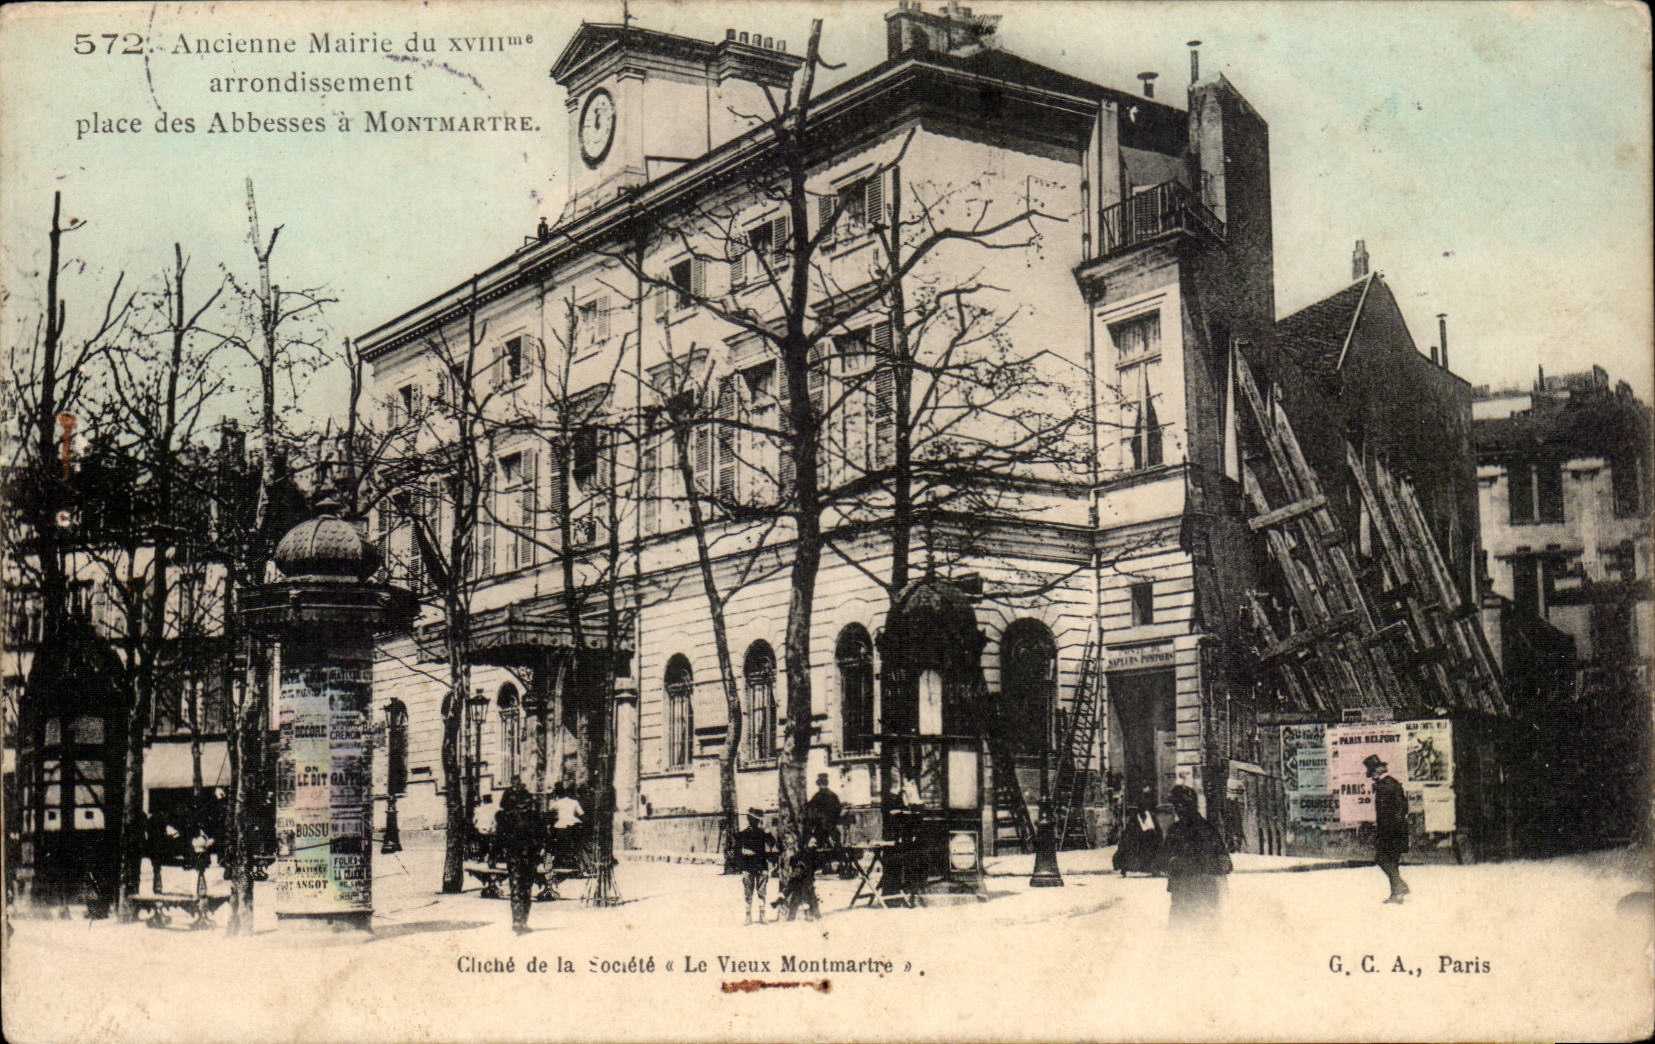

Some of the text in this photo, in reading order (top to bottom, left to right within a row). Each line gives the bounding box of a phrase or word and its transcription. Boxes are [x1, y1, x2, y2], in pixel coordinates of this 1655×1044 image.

[304, 765, 320, 773] ON
[297, 773, 309, 787] LE
[311, 772, 328, 787] DIT
[1340, 783, 1367, 796] PARIS
[1301, 799, 1339, 808] COURSES
[295, 822, 329, 838] BOSSU
[296, 879, 329, 890] ANGOT
